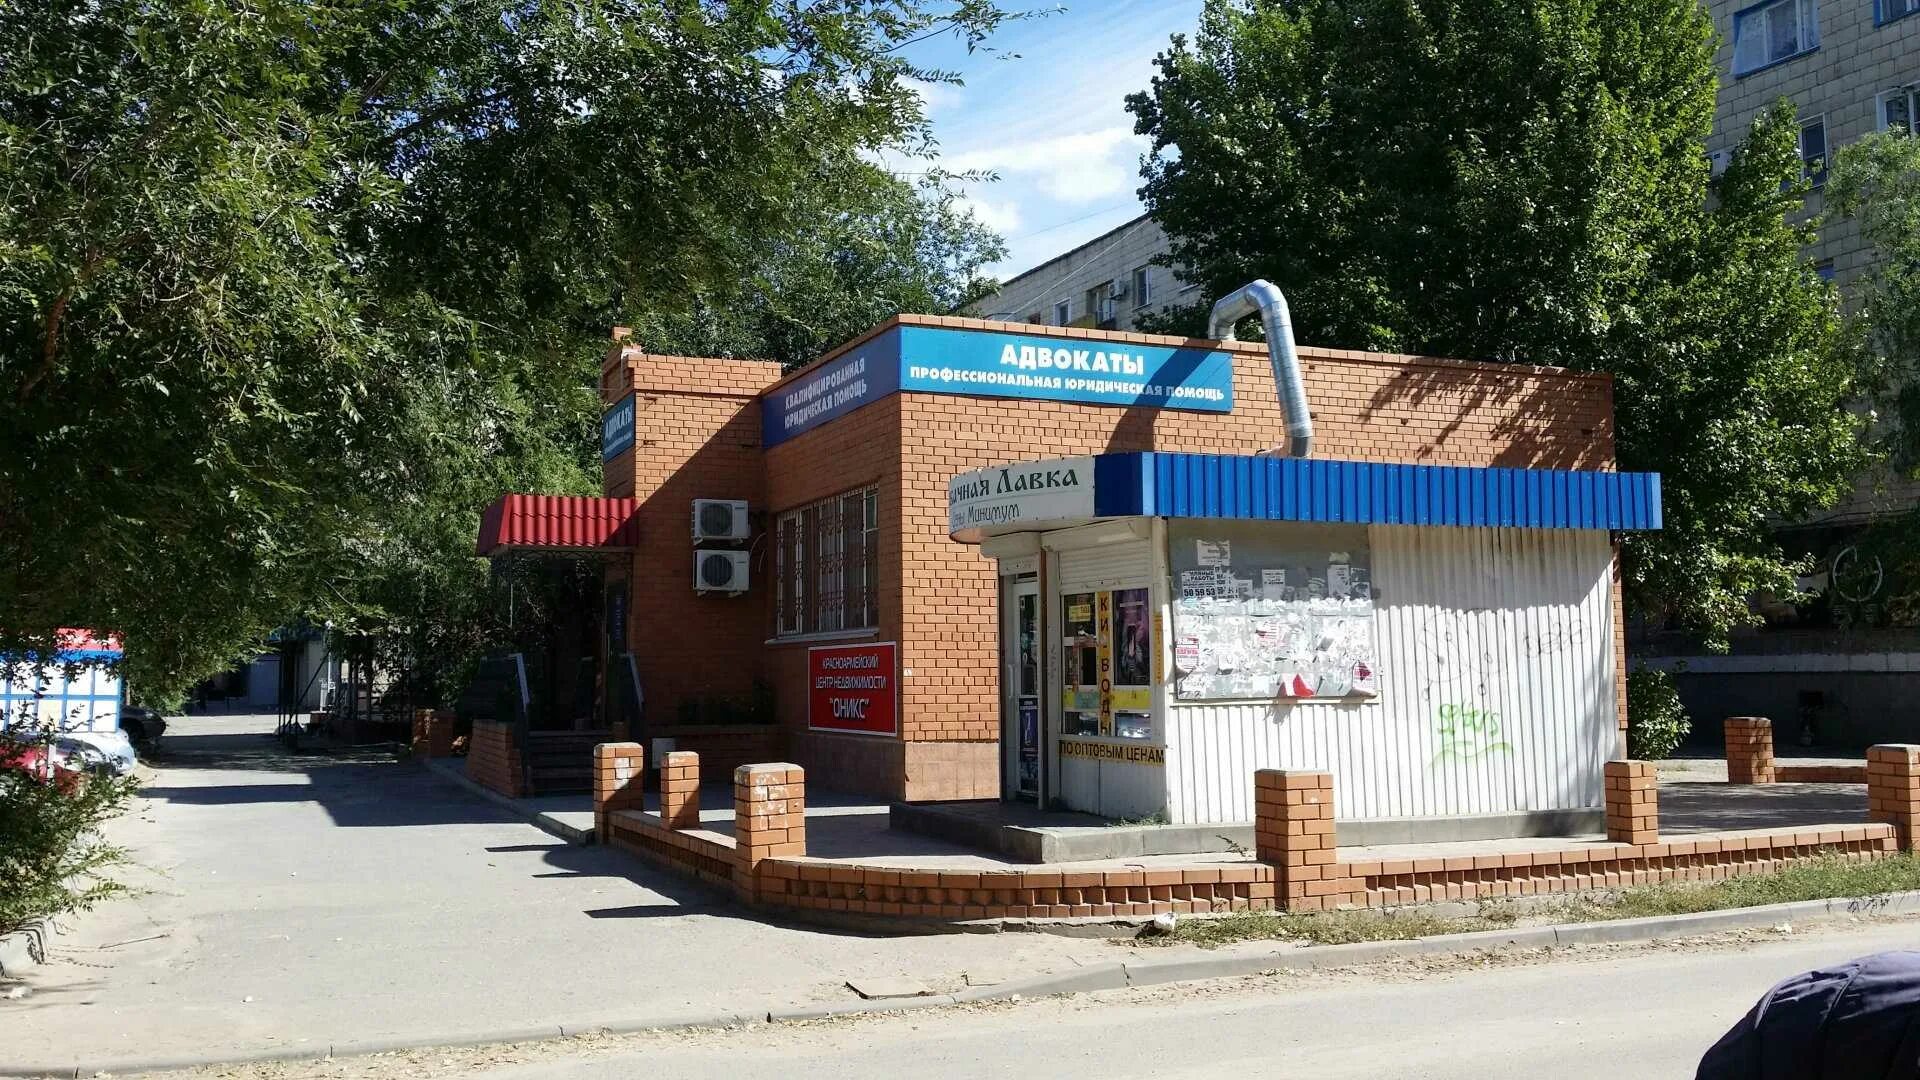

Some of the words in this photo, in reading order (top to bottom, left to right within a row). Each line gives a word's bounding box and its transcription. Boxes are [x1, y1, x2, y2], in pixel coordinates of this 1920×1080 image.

[1000, 343, 1144, 376] АДВОКАТЫ
[785, 357, 865, 411] КВАЛИФИЦИРОВАННАЯ
[910, 366, 1062, 390] ПРОФЕССИОНАЛЬНАЯ
[1064, 377, 1163, 397] ЮРИДИЧЕСКАЯ
[1165, 385, 1225, 402] ПОМОЩЬ
[784, 394, 833, 430] ЮРИДИЧЕСКАЯ
[834, 378, 867, 408] ПОМОЩЬ
[996, 468, 1079, 494] Лавка
[815, 676, 833, 689] ЦЕНТР
[829, 697, 870, 719] "ОНИКС"
[1060, 742, 1074, 754] ПО
[1074, 743, 1123, 759] ОПТОВЫМ
[1126, 748, 1165, 764] ЦЕНАМ
